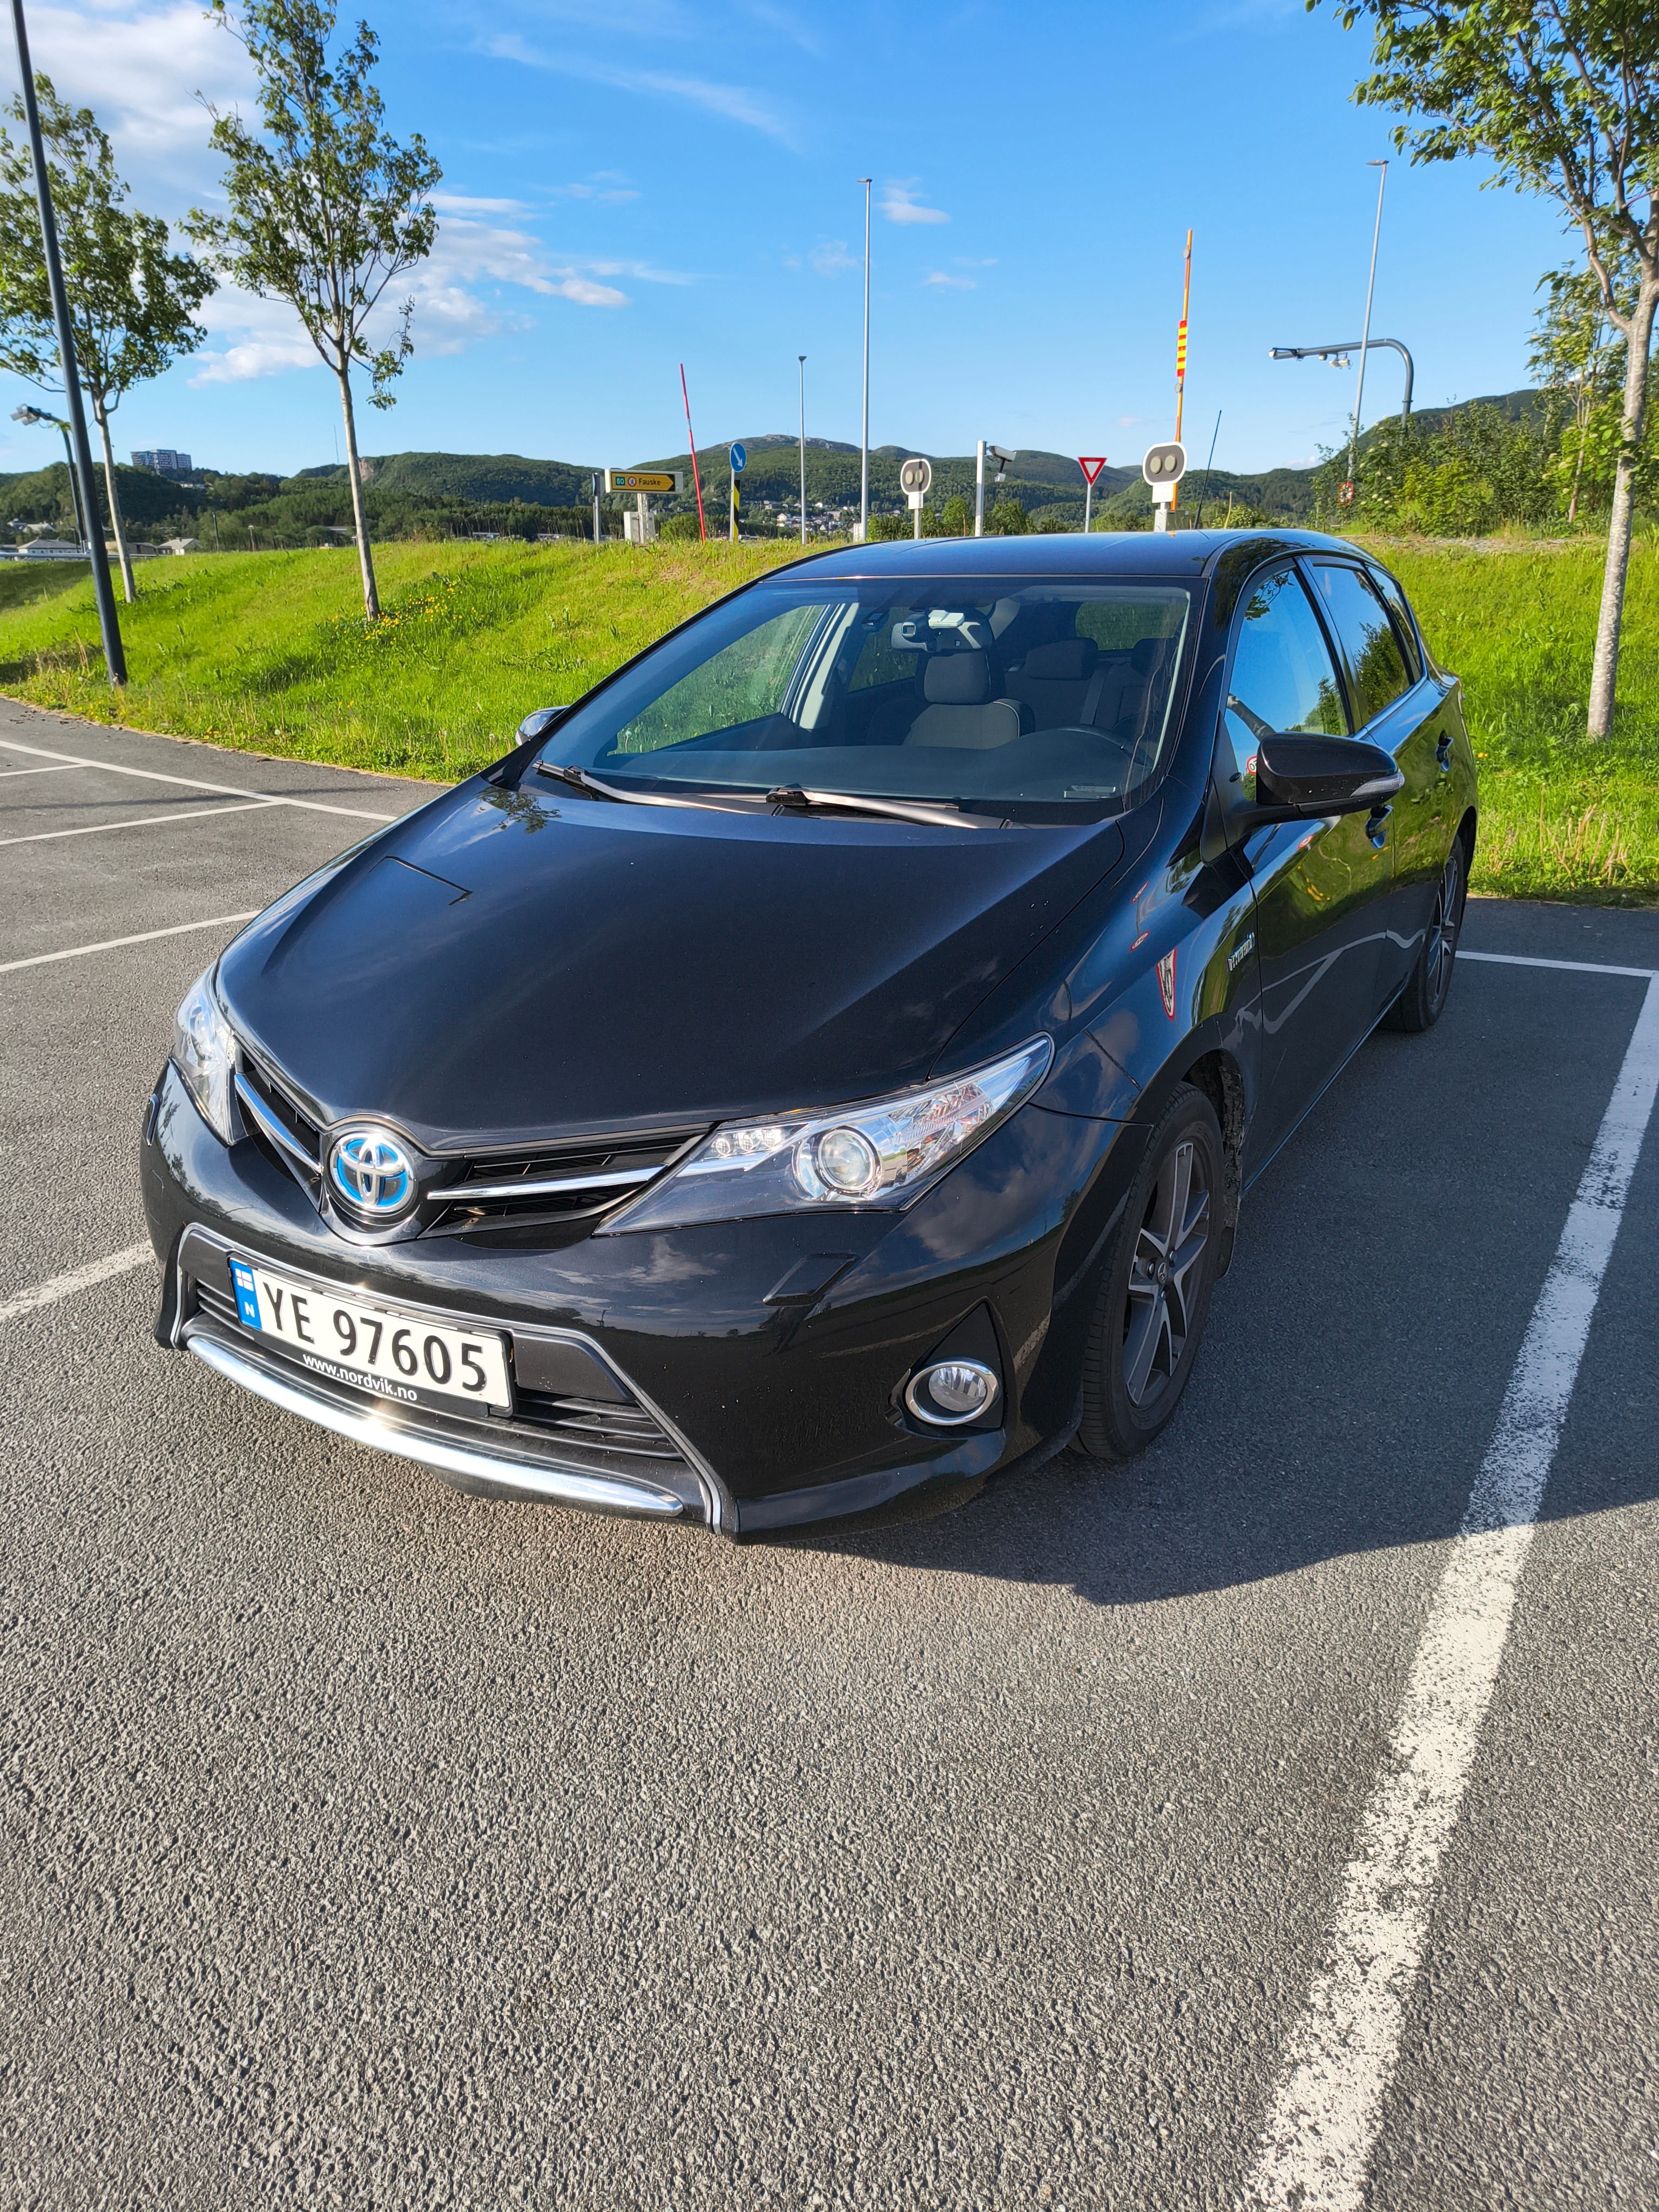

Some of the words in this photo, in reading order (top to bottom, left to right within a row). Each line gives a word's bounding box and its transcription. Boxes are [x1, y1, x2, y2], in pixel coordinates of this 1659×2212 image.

[245, 1301, 255, 1318] N
[263, 1282, 315, 1344] YE
[333, 1309, 487, 1392] 97605
[302, 1354, 417, 1401] www.nordvik.no
